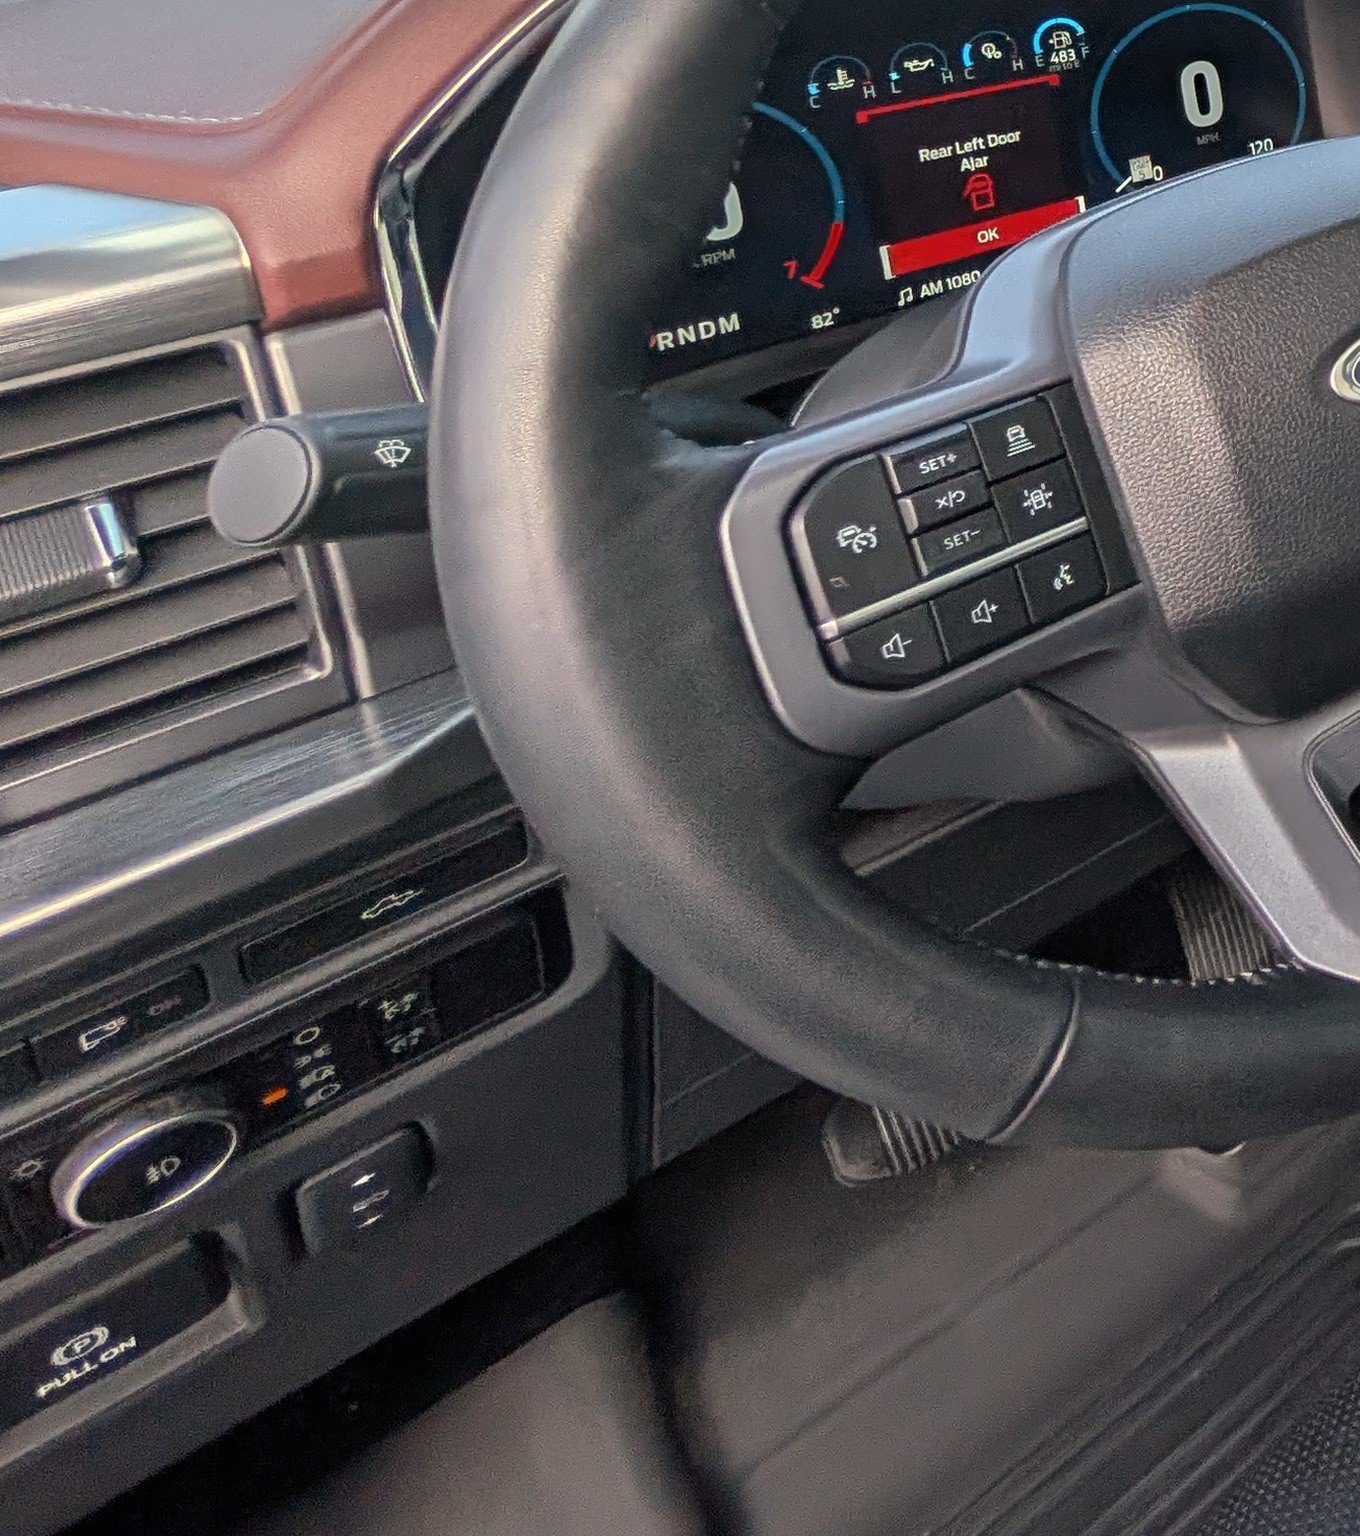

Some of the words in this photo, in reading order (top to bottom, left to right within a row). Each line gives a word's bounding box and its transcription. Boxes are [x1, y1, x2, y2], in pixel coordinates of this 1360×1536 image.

[1050, 49, 1076, 64] 483
[1013, 59, 1024, 72] H
[942, 71, 954, 85] H
[963, 68, 975, 81] C
[863, 85, 877, 100] H
[891, 81, 902, 95] L
[1180, 60, 1224, 128] 0
[809, 96, 821, 109] C
[918, 147, 953, 163] Rear
[955, 137, 986, 154] Left
[987, 130, 1022, 148] Door
[1250, 138, 1274, 156] 120
[960, 156, 989, 172] Ajar
[1153, 165, 1164, 182] 0
[977, 227, 1000, 244] OK
[701, 248, 736, 267] RPM
[920, 280, 944, 299] AM
[945, 269, 982, 291] 1080
[811, 307, 840, 330] 82°
[36, 1362, 99, 1398] PULL
[99, 1336, 137, 1363] ON
